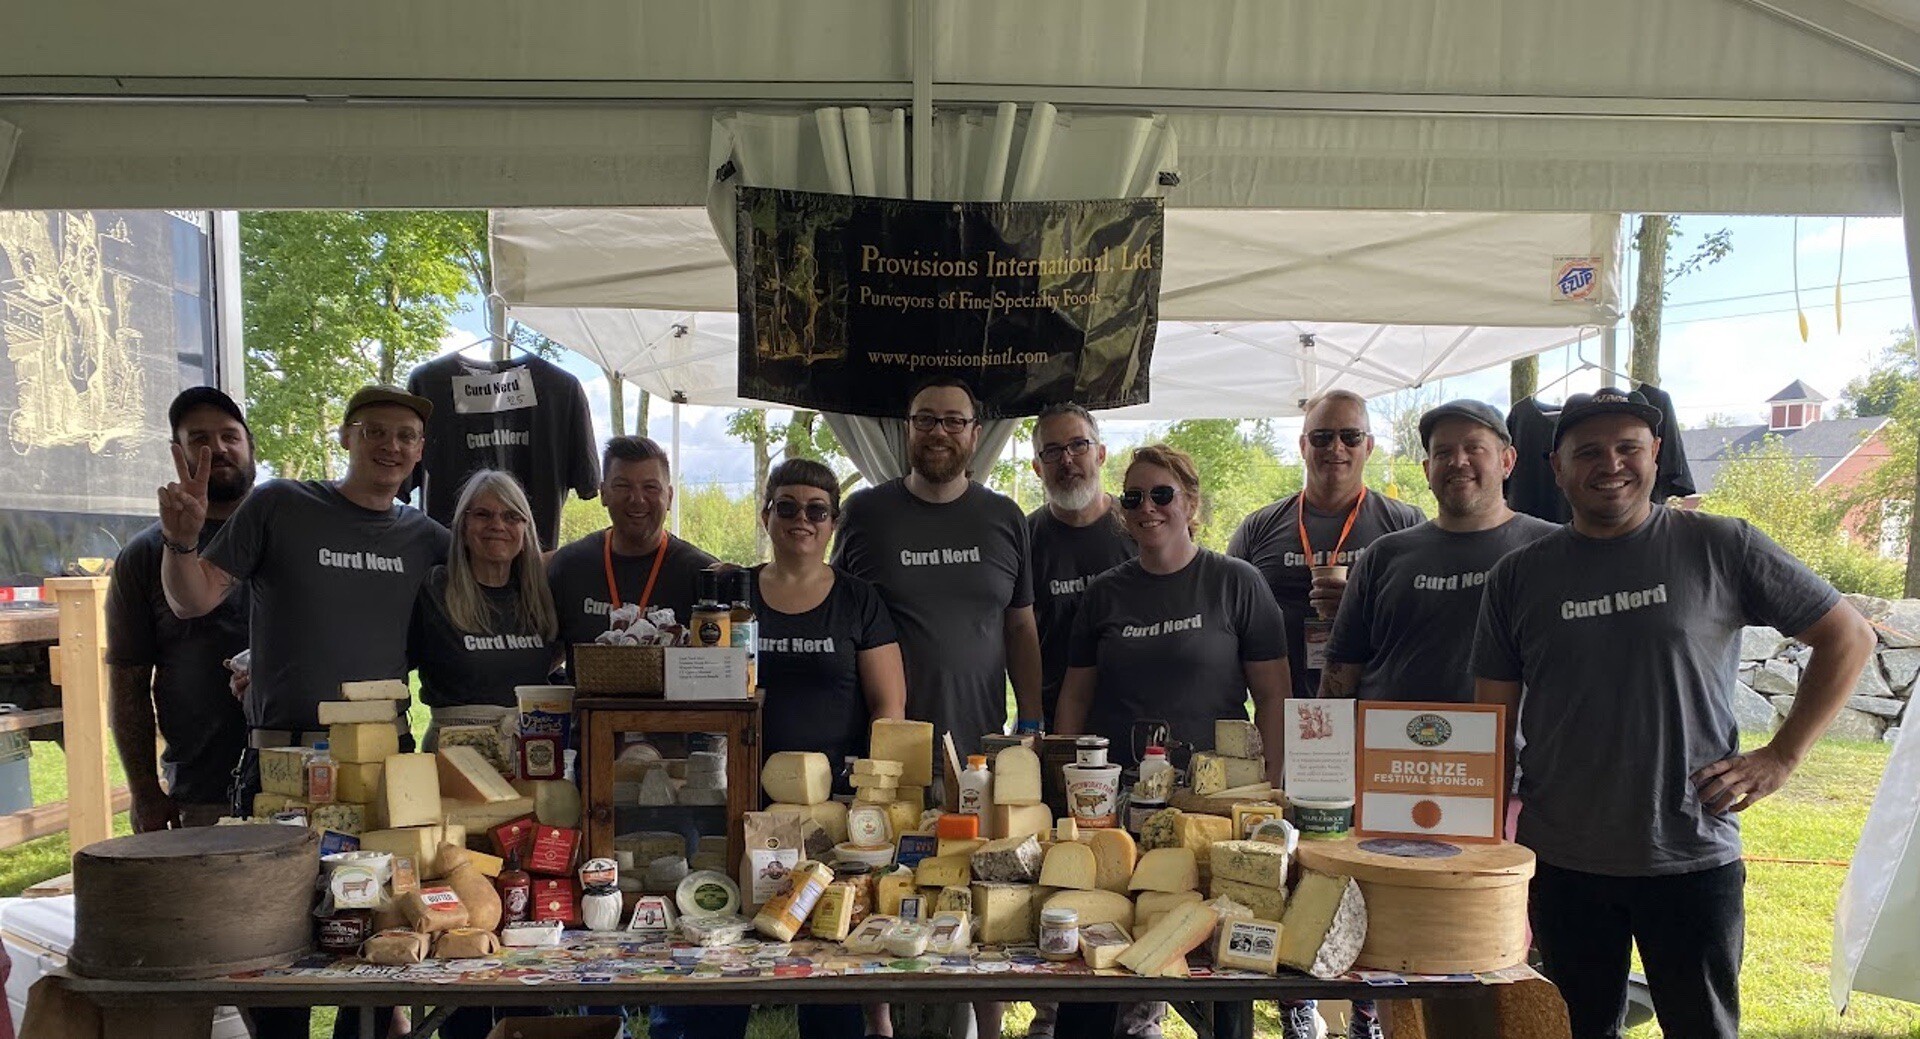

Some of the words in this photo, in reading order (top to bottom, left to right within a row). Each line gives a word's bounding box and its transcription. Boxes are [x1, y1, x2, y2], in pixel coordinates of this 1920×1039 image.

[861, 245, 978, 277] Provisions
[986, 249, 1114, 279] International,
[1121, 244, 1152, 271] Ltd
[859, 286, 935, 314] Purveyors
[939, 292, 955, 311] of
[959, 292, 991, 310] Fine
[993, 292, 1061, 314] Specialty
[1063, 289, 1102, 307] Foods
[867, 346, 1049, 371] www.provisionsintl.com
[464, 383, 492, 397] Curd
[493, 378, 520, 395] Nerd
[466, 429, 500, 449] Curd
[501, 428, 529, 446] Nerd
[318, 548, 363, 569] Curd
[366, 551, 405, 573] Nerd
[901, 549, 940, 567] Curd
[942, 547, 981, 565] Nerd
[1284, 550, 1323, 567] Cud
[1049, 575, 1085, 596] Curd
[1414, 573, 1458, 591] Curd
[1462, 571, 1492, 589] Ner
[583, 597, 613, 616] Cur
[1560, 594, 1612, 621] Curd
[1615, 583, 1668, 613] Nerd
[1121, 621, 1161, 639] Curd
[1163, 613, 1204, 634] Nerd
[464, 634, 505, 651] Curd
[507, 633, 544, 650] Nerd
[757, 636, 789, 654] urd
[792, 636, 836, 654] Nerd
[1391, 760, 1468, 777] BRONZE
[1374, 773, 1426, 785] FESTIVAL
[1429, 775, 1484, 787] SPONSOR
[427, 893, 454, 903] BUTTER
